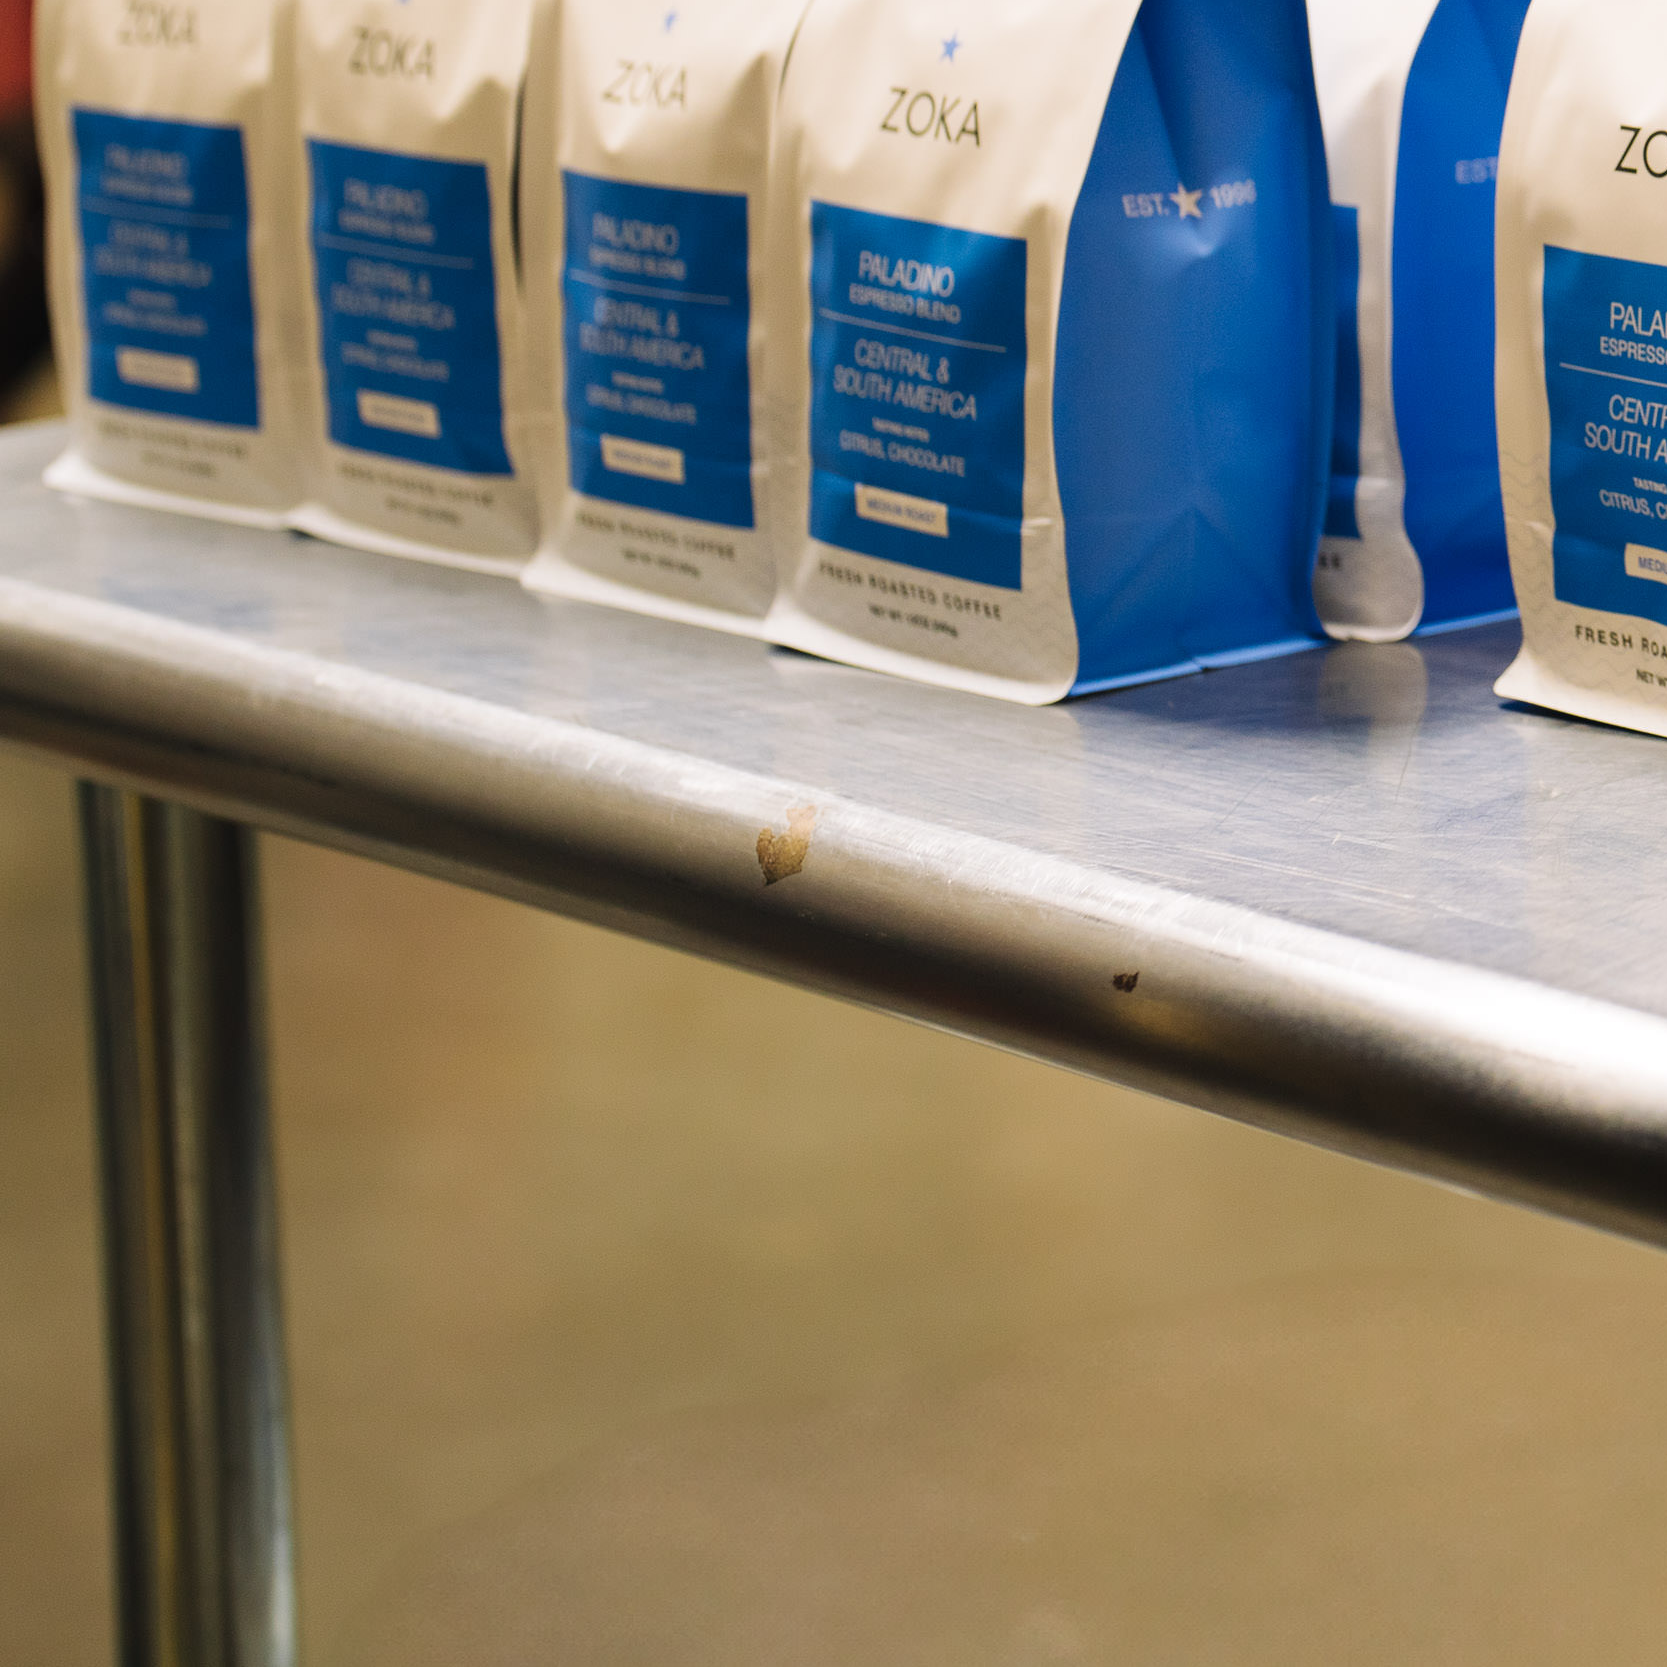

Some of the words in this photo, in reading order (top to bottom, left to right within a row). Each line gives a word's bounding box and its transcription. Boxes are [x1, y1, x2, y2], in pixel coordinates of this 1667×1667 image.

[880, 86, 981, 148] ZOKA
[1122, 192, 1170, 219] EST.
[858, 250, 955, 298] PALADINO
[854, 338, 933, 382] CENTRAL
[936, 357, 950, 384] &
[833, 364, 893, 404] SOUTH
[893, 382, 977, 422] AMERICA
[1584, 422, 1650, 460] SOUTH
[1600, 489, 1654, 519] CITRUS,
[1633, 477, 1667, 496] TASTING
[1575, 624, 1633, 649] FRESH
